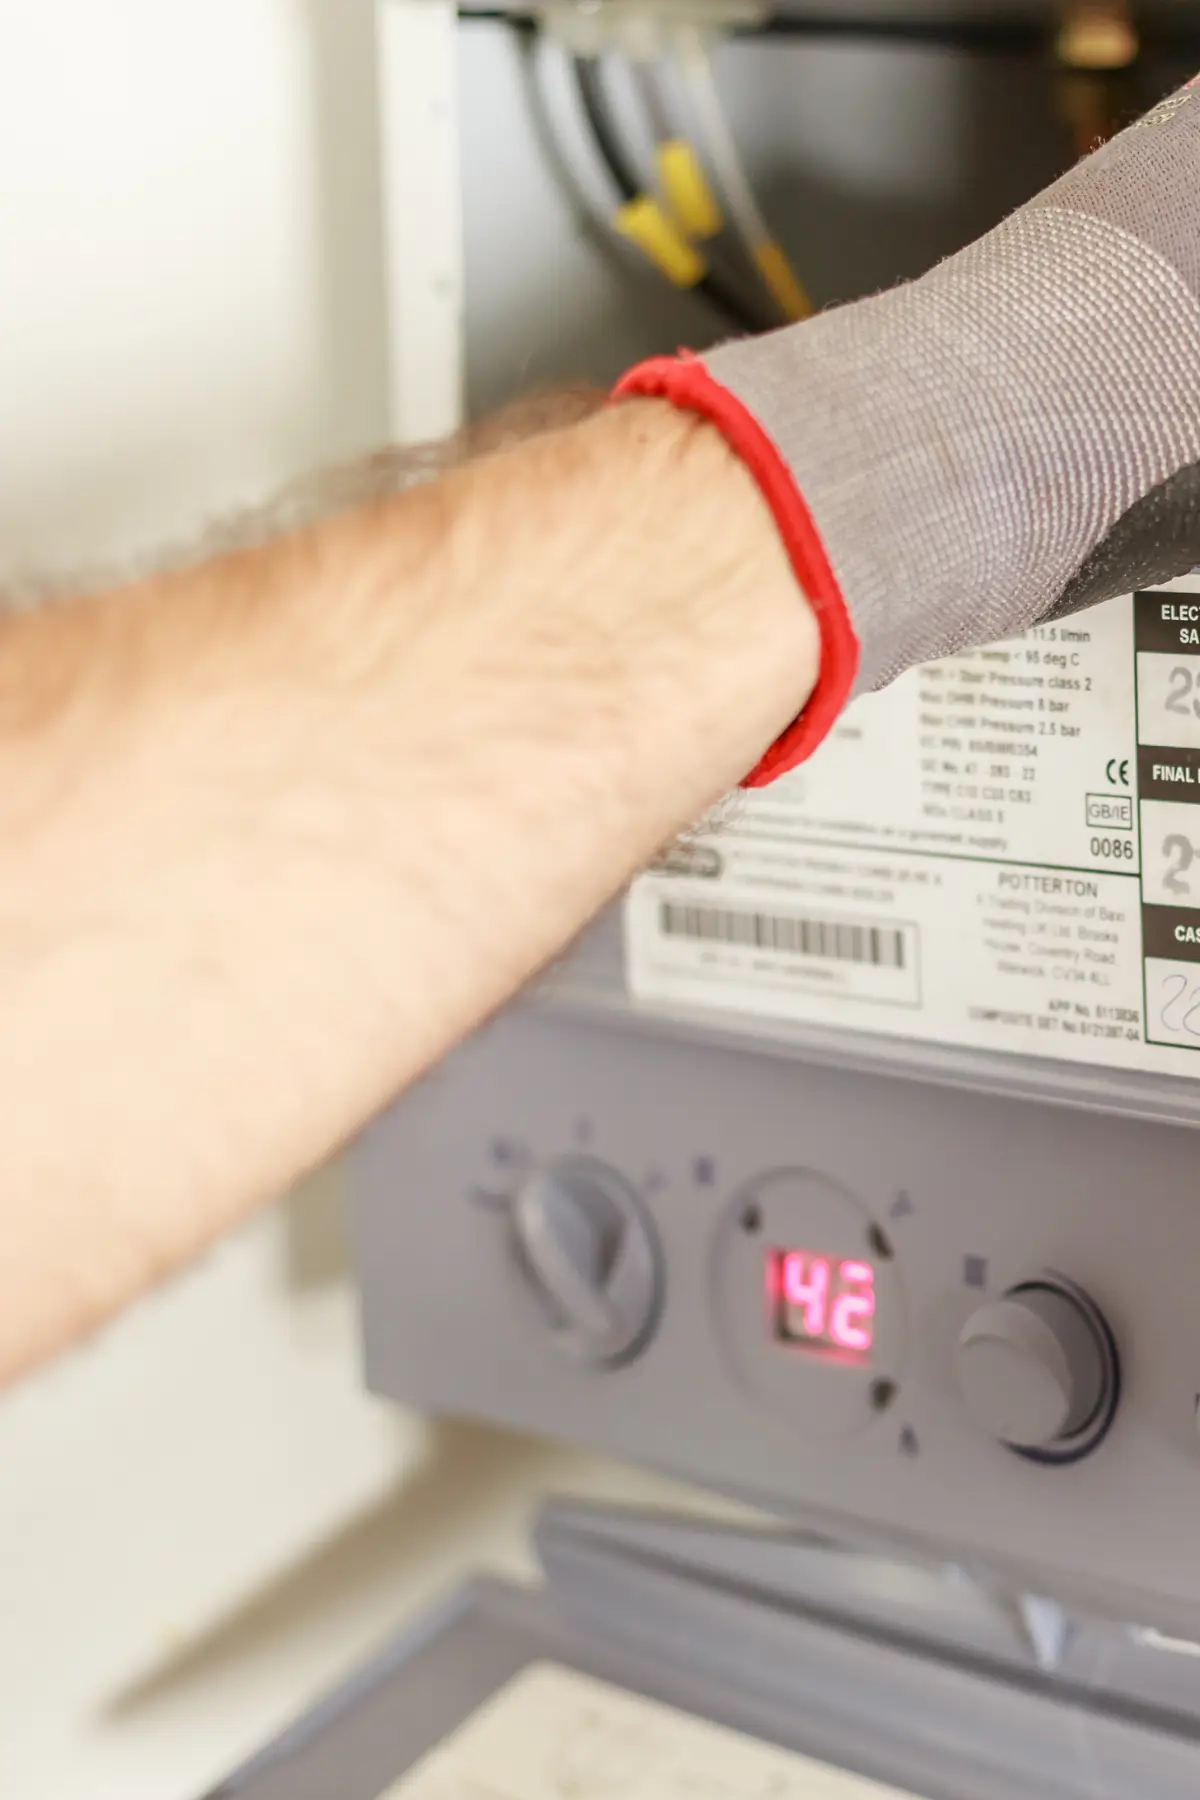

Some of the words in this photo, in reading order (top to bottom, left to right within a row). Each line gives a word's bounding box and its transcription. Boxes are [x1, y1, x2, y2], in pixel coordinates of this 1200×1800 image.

[1070, 653, 1080, 666] C
[1084, 677, 1092, 691] 2
[1152, 764, 1195, 784] FINAL
[1089, 803, 1130, 822] GB/IE
[1090, 837, 1134, 859] 0086
[998, 871, 1099, 899] POTTERTON
[783, 1252, 875, 1351] 42
